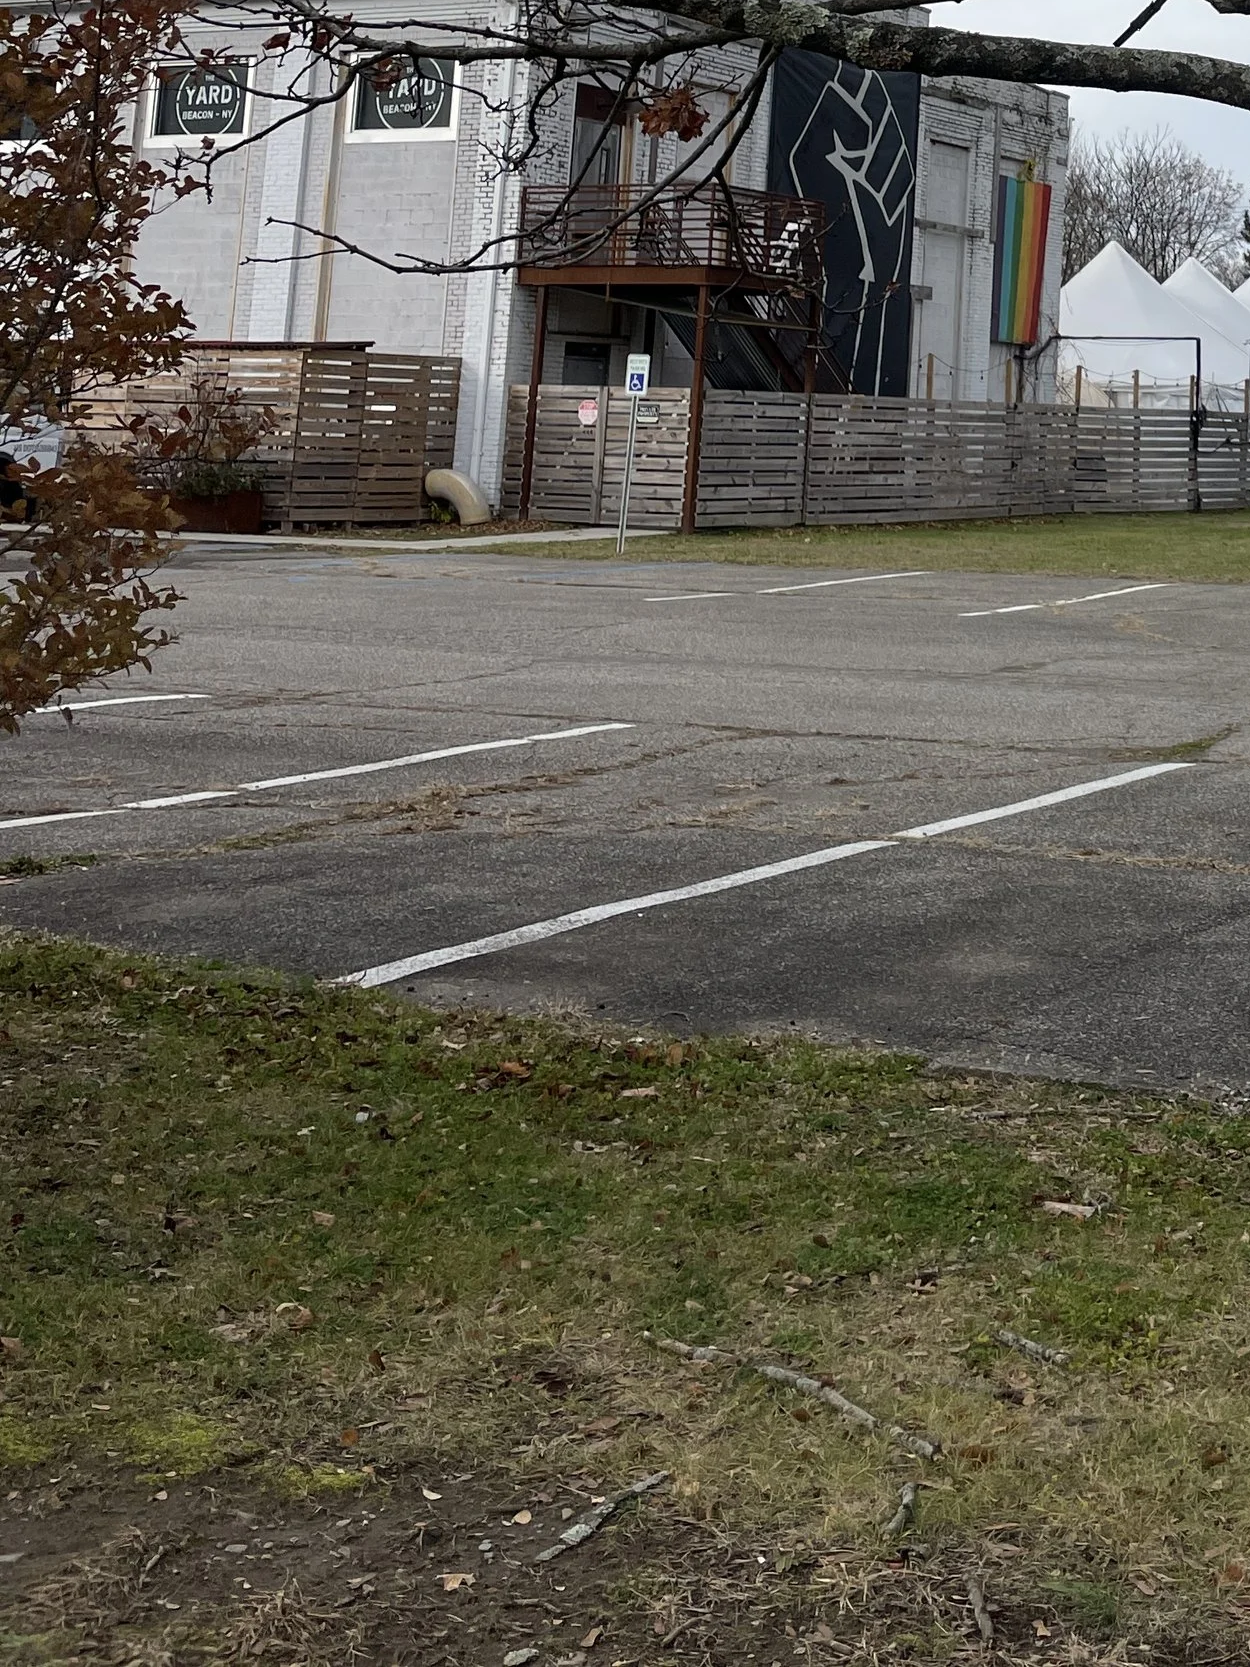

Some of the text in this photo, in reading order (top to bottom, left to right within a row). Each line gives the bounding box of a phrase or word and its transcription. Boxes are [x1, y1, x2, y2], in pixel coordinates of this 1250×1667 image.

[185, 84, 232, 105] YARD
[182, 110, 213, 120] BEACON
[222, 109, 233, 118] NY
